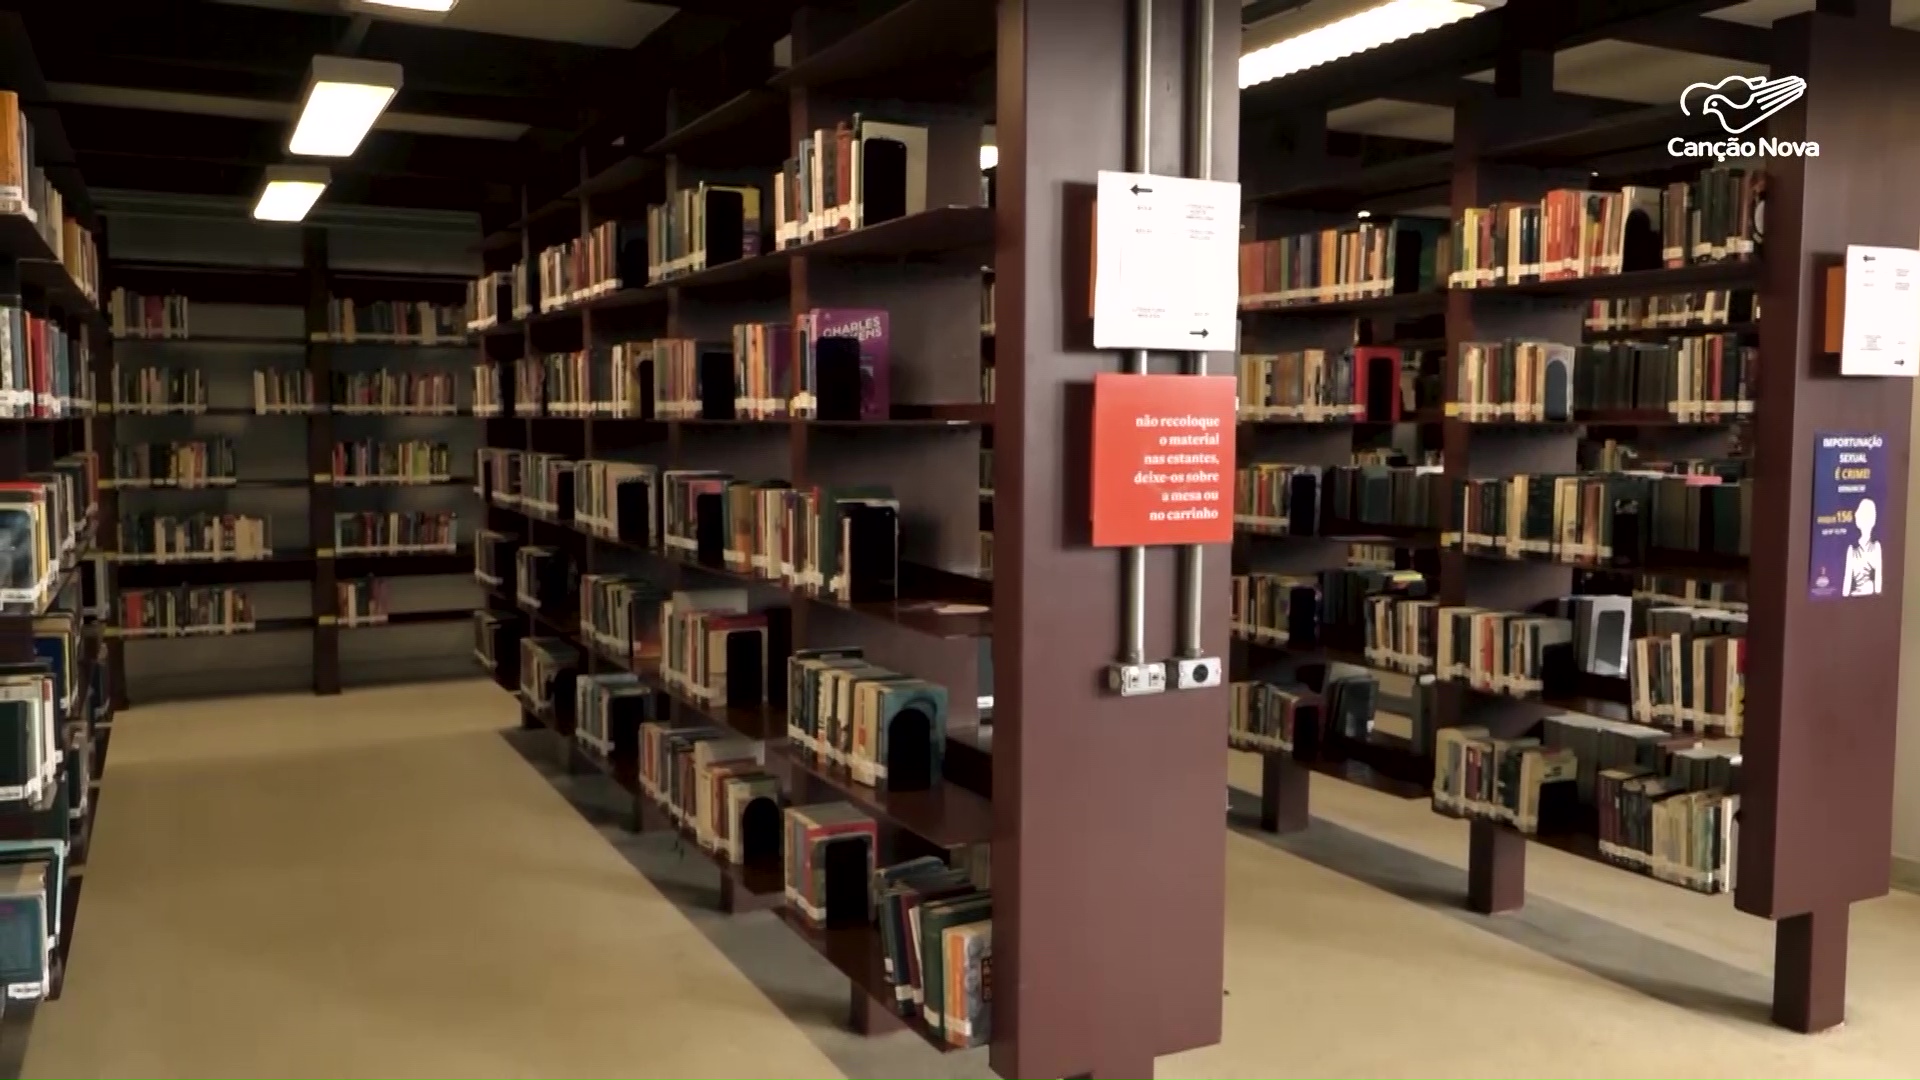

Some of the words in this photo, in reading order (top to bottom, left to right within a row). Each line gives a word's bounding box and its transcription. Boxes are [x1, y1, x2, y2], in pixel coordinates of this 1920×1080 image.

[823, 316, 880, 337] CHARLES
[1135, 414, 1158, 427] não
[1160, 414, 1220, 431] recoloque
[1159, 436, 1168, 446] o
[1169, 432, 1220, 446] material
[1823, 435, 1883, 450] IMPORTUNAÇÃO
[1144, 454, 1165, 465] nas
[1167, 453, 1220, 465] estantes,
[1839, 452, 1868, 463] SEXUAL
[1134, 470, 1184, 485] deixe-os
[1186, 470, 1220, 483] sobre
[1161, 492, 1169, 502] a
[1170, 491, 1202, 501] mesa
[1203, 490, 1219, 501] ou
[1149, 510, 1165, 521] no
[1167, 506, 1219, 520] carrinho
